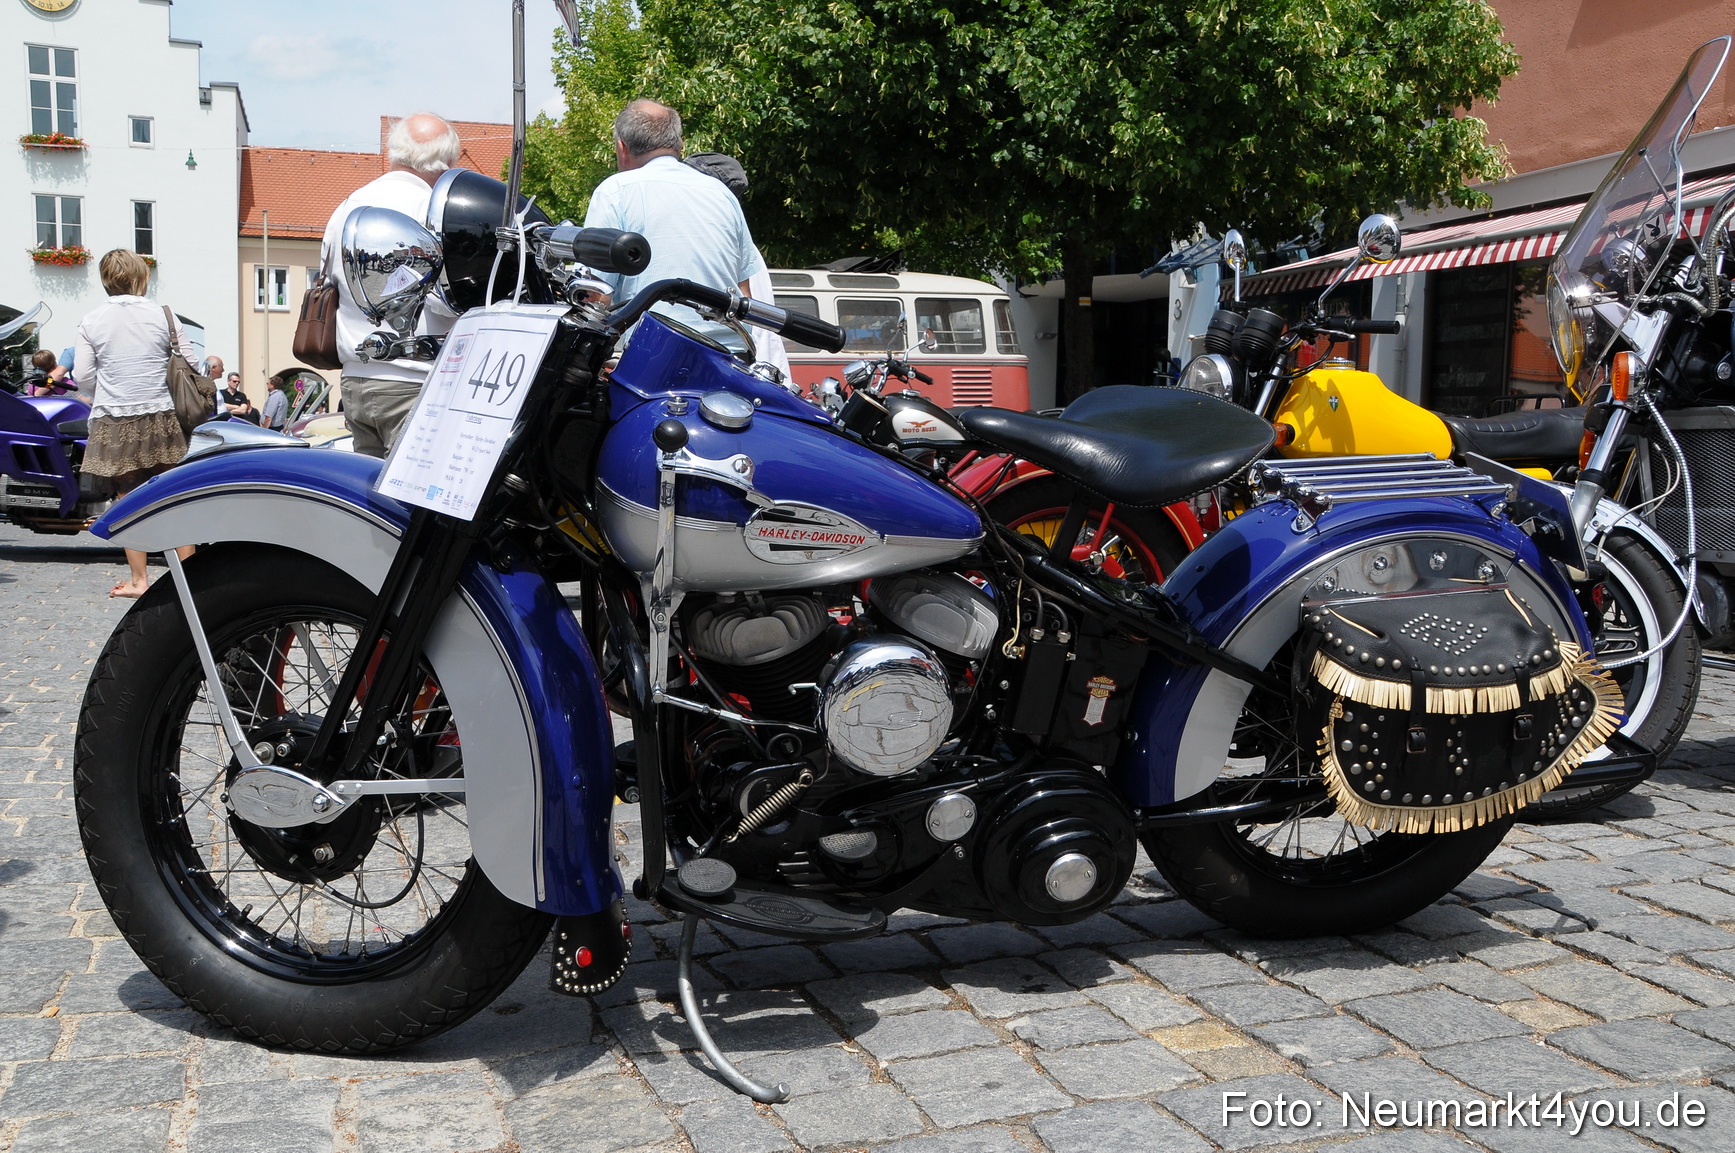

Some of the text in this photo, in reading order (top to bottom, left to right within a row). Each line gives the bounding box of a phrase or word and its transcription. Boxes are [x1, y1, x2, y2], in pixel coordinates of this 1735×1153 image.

[1174, 298, 1182, 320] 3
[468, 348, 525, 406] 449
[758, 527, 866, 545] HARLEY-DAVIDSON
